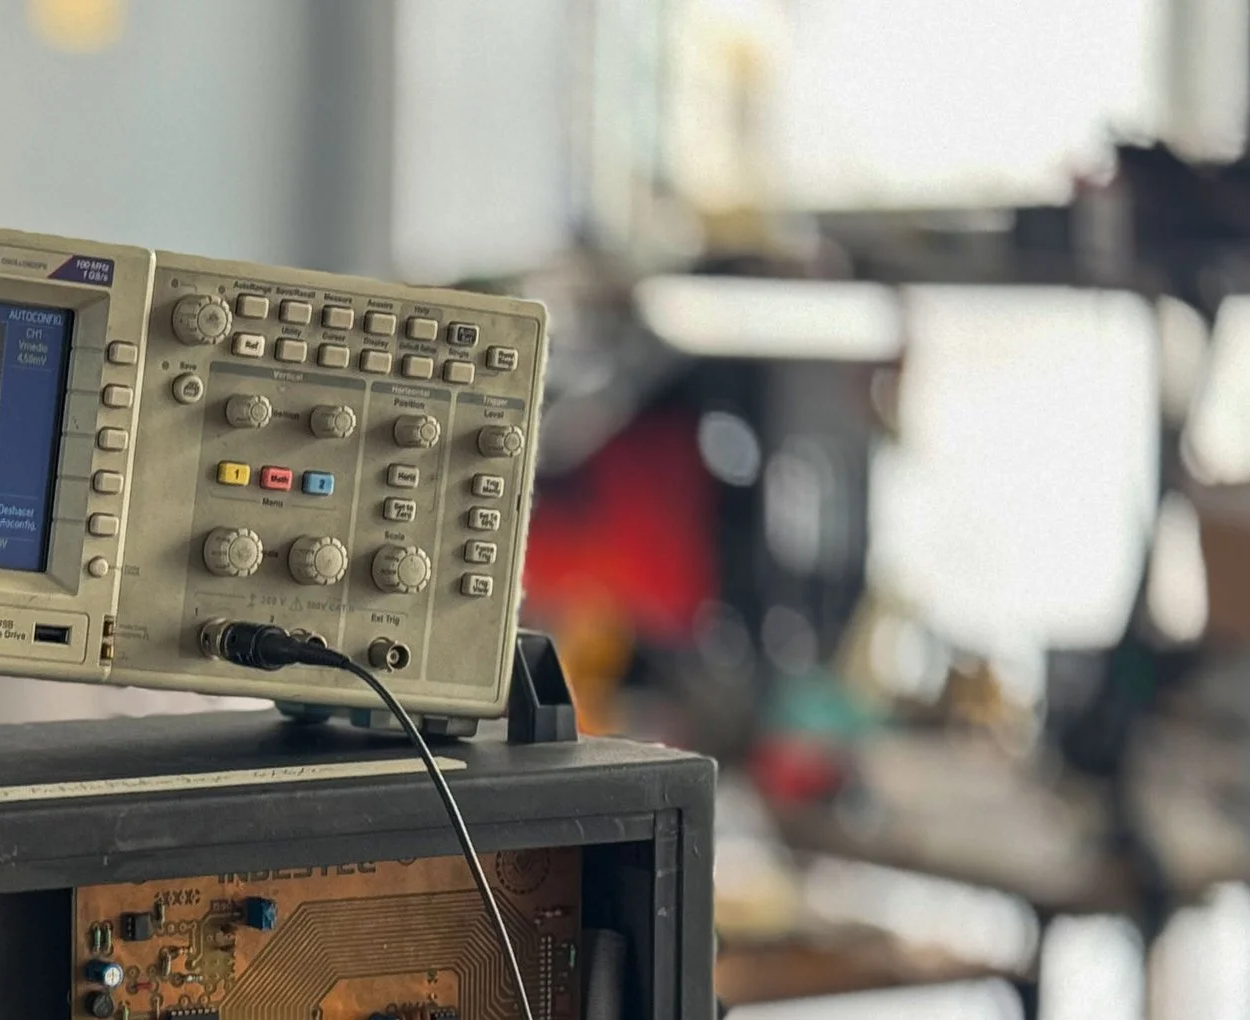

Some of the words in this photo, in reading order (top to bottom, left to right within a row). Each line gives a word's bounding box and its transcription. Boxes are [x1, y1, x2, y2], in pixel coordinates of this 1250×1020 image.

[76, 259, 90, 269] 100
[91, 261, 110, 273] MHz
[26, 327, 43, 340] CH1
[281, 326, 302, 338] Utility
[273, 370, 303, 382] Vertical
[391, 385, 431, 398] Horizontal
[394, 398, 425, 410] Position
[483, 409, 504, 420] Level
[318, 478, 326, 490] 2
[261, 497, 284, 508] Menu
[371, 613, 384, 623] Ext
[385, 614, 401, 626] Trig
[4, 629, 27, 641] Drive
